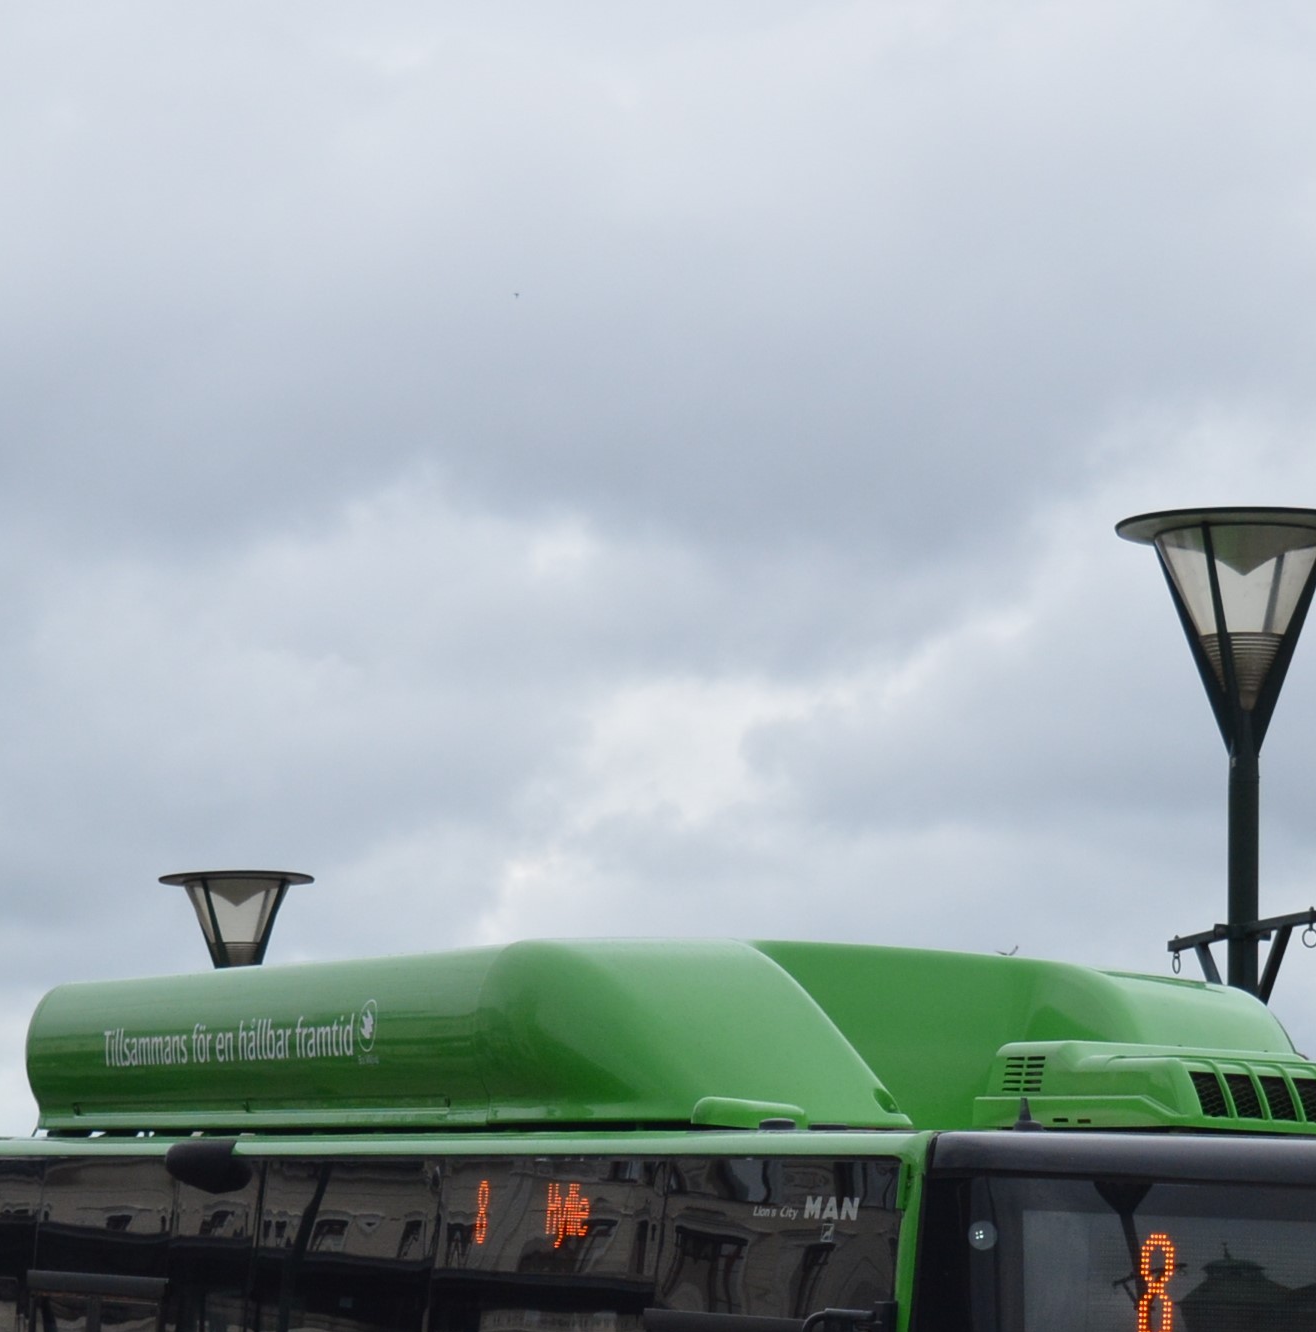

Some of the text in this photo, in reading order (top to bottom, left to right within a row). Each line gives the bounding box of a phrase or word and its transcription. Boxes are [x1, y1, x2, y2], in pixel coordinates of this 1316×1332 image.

[104, 1013, 355, 1067] Tillsammans för en hållbar framtid
[475, 1180, 590, 1249] 8 Hyllie
[752, 1195, 860, 1221] Lion's City MAN
